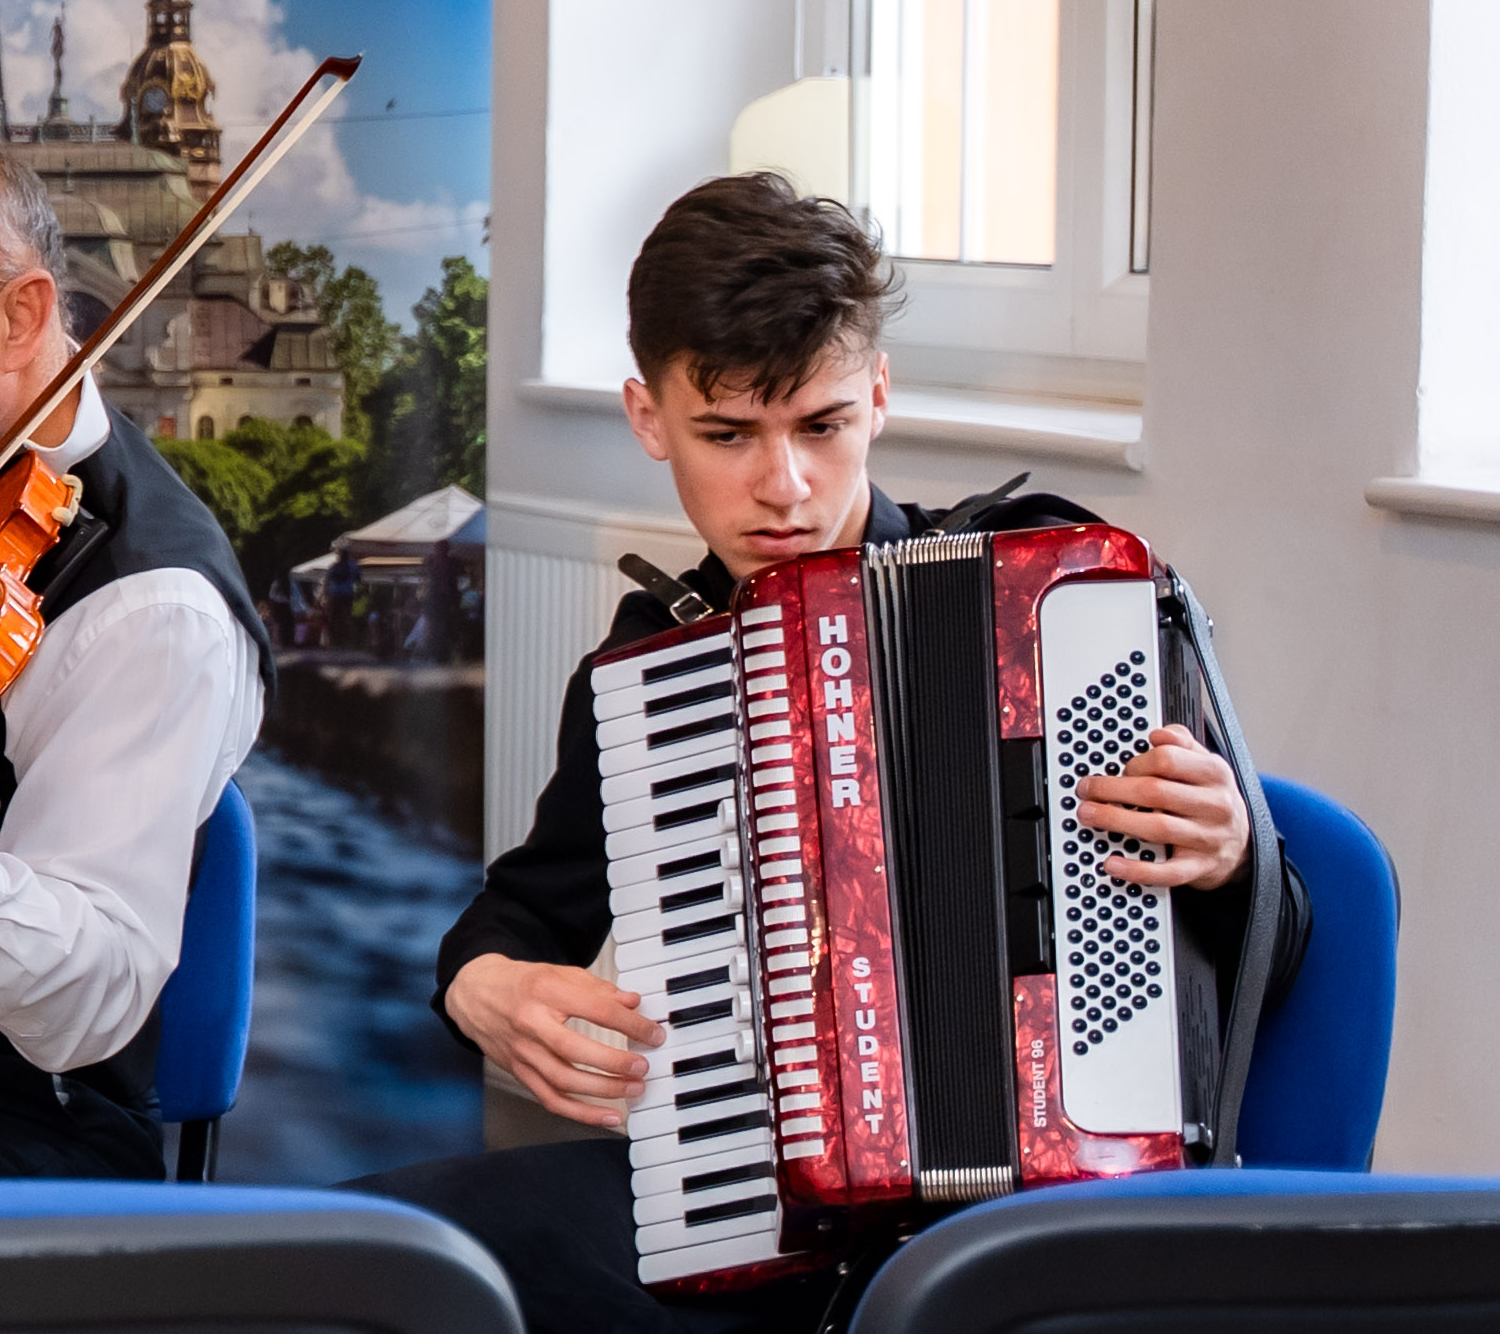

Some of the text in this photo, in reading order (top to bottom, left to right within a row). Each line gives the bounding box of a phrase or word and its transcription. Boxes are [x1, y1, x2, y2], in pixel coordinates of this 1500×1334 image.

[818, 614, 861, 808] HOHNER
[852, 956, 884, 1134] STUDENT
[1031, 1039, 1047, 1128] STUDENT 96
